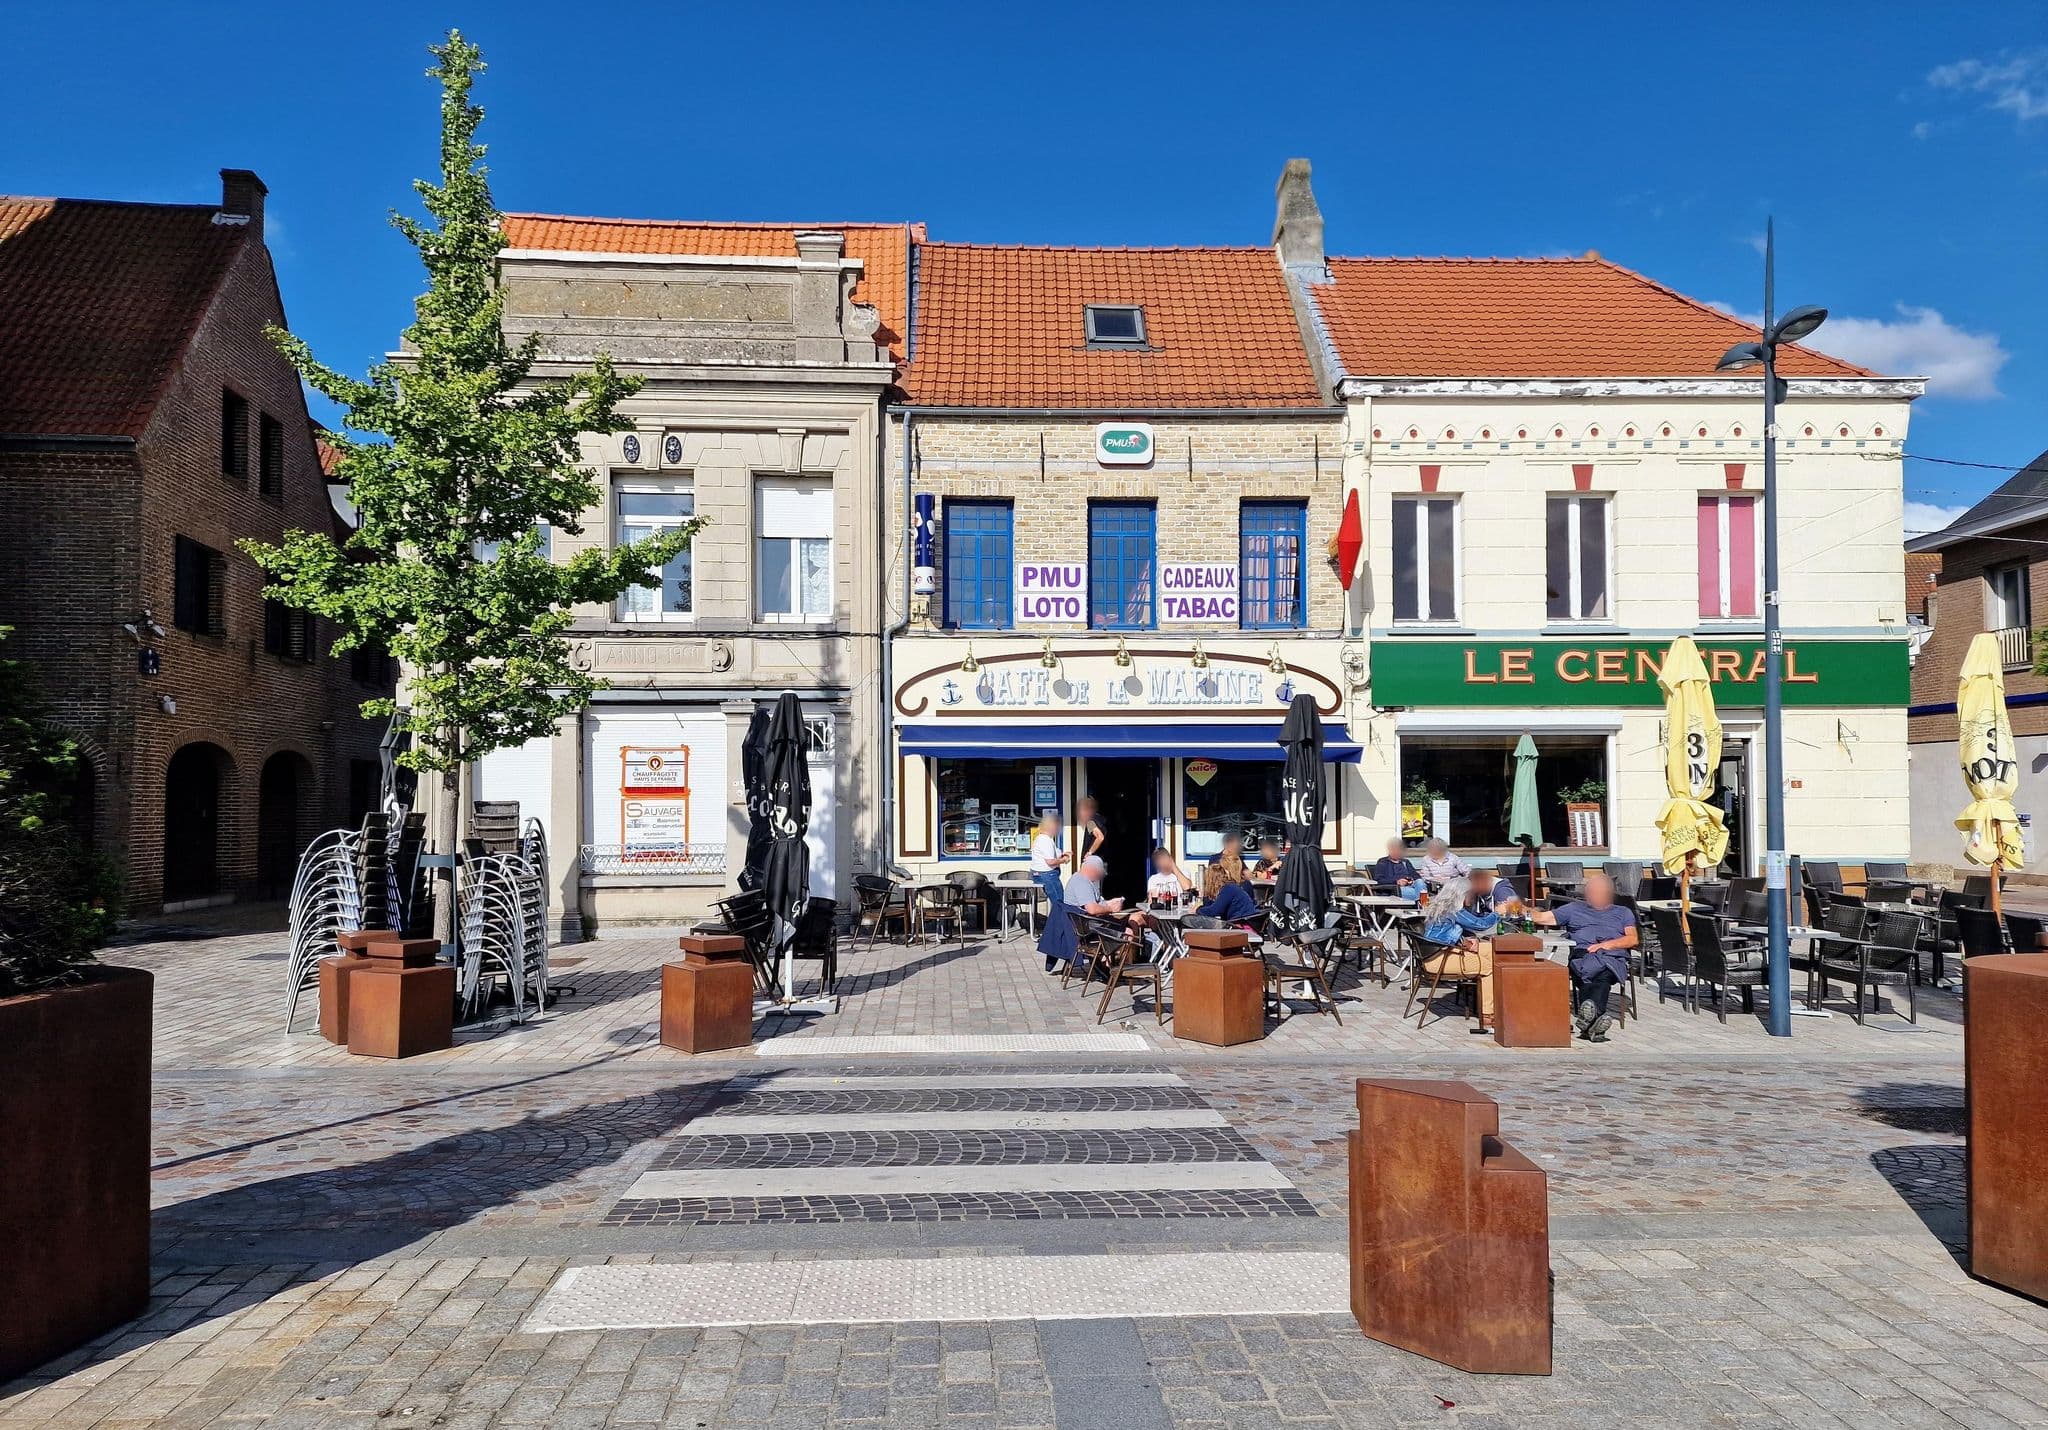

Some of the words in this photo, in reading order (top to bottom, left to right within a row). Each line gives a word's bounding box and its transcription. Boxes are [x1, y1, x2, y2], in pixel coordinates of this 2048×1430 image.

[1105, 438, 1128, 448] PMU
[1022, 567, 1081, 587] PMU
[1163, 567, 1235, 588] CADEAUX
[1023, 597, 1080, 617] LOTO
[1163, 598, 1235, 617] TABAC
[605, 647, 657, 664] ANNO
[1464, 648, 1535, 683] LE
[1555, 648, 1818, 683] CENRAL
[1067, 680, 1090, 705] DE
[1106, 680, 1129, 705] LA
[1147, 668, 1263, 705] MARINE
[1687, 733, 1704, 758] 3
[626, 802, 682, 818] SAUVAGE
